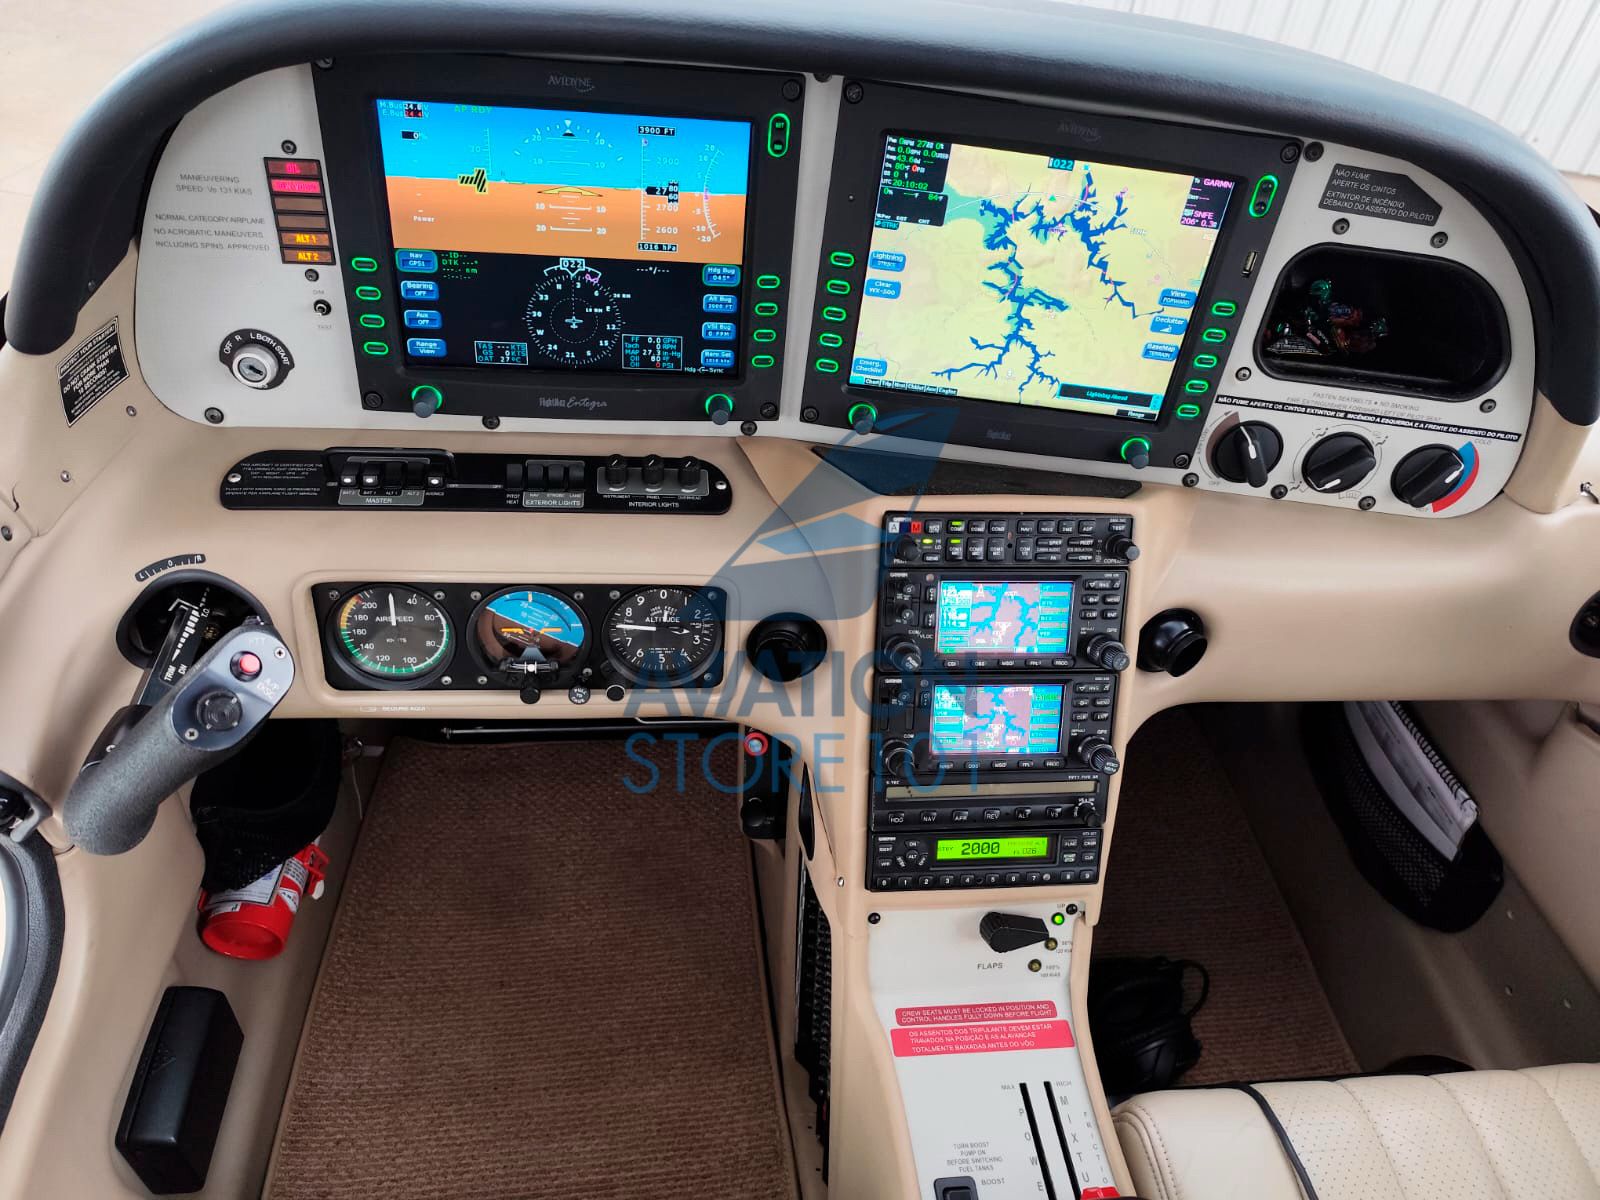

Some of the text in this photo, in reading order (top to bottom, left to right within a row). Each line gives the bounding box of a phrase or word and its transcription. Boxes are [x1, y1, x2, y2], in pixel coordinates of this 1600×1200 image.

[1336, 169, 1350, 178] NÃO
[180, 174, 240, 184] MANEUVERING
[1204, 178, 1232, 188] GARMN
[176, 184, 203, 192] SPEED
[893, 179, 928, 190] 20:10:02
[1332, 179, 1358, 188] APERTE
[1371, 185, 1396, 195] CINTOS
[1326, 191, 1360, 201] EXTINTOR
[1194, 211, 1214, 219] SNFE
[1323, 199, 1354, 208] DEBAIXO
[1365, 205, 1397, 216] ASSENTO
[1410, 212, 1434, 222] PILOTO
[168, 228, 213, 236] ACROBATIC
[214, 230, 264, 238] MANEUVERS
[296, 234, 309, 243] ALT
[155, 240, 198, 249] INCLUDING
[227, 243, 270, 251] APPROVED
[298, 252, 311, 261] ALT
[873, 252, 903, 262] Lightning
[224, 340, 232, 354] OFF
[256, 333, 276, 347] BOTH
[275, 345, 290, 365] START
[1307, 408, 1336, 416] EXTINTOR
[1381, 418, 1413, 427] ESQUERDA
[1424, 423, 1448, 431] FRENTE
[1459, 427, 1486, 436] ASSENTO
[660, 590, 667, 599] 0
[636, 596, 645, 605] 9
[626, 608, 701, 619] 8 2
[626, 635, 700, 647] 7 3
[636, 649, 644, 657] 6
[659, 654, 665, 663] 5
[680, 648, 688, 656] 4
[960, 842, 1000, 855] 2000
[970, 1026, 1008, 1034] TRIPULANTE
[956, 1034, 983, 1042] POSIÇÃO
[981, 1177, 1005, 1186] BOOST
